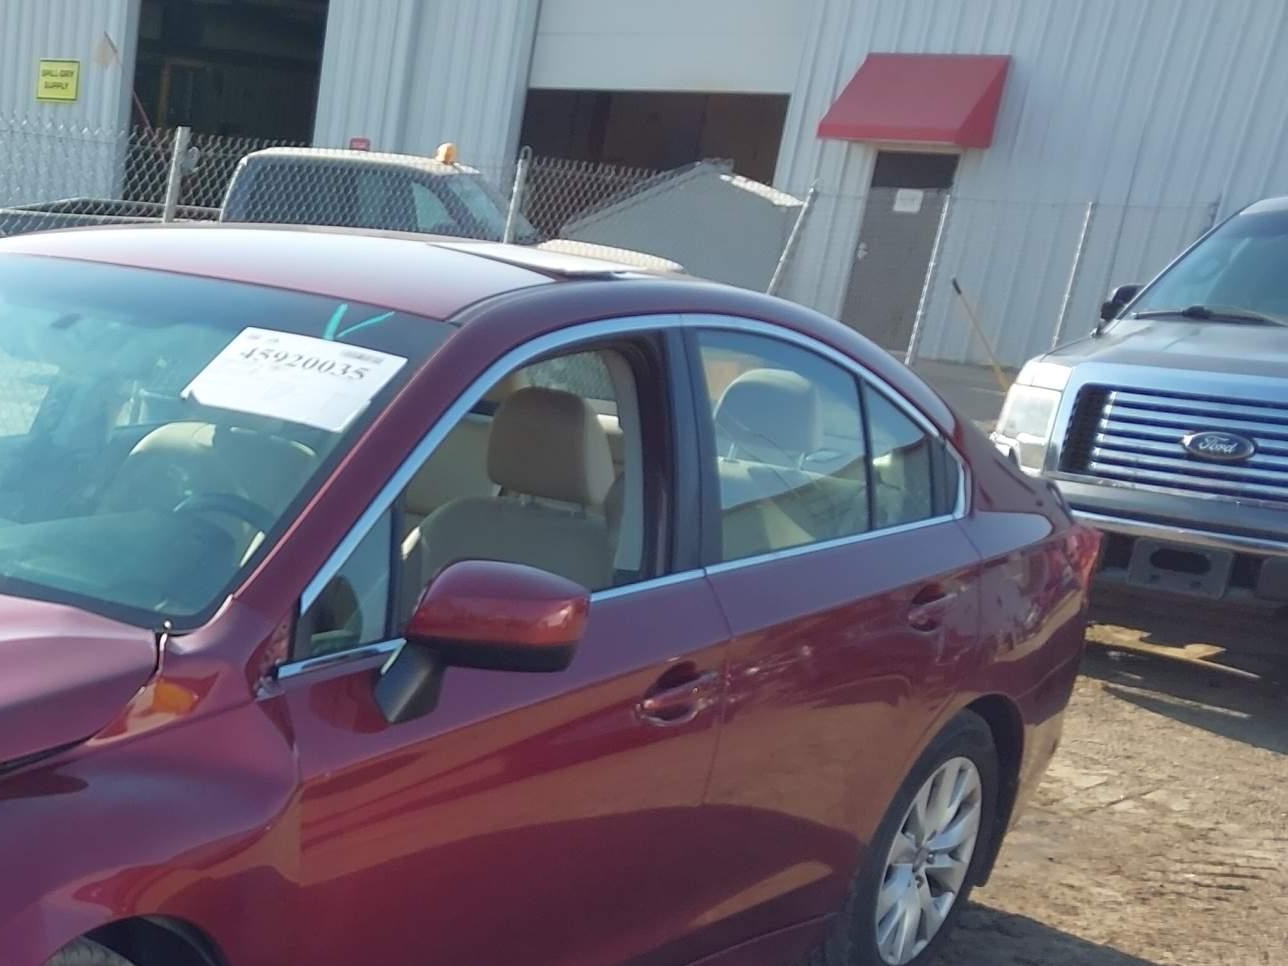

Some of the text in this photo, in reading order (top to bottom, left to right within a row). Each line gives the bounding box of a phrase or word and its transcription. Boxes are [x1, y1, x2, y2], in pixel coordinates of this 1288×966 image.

[44, 81, 69, 90] SUPPLY
[240, 346, 370, 381] 45920035
[1198, 435, 1238, 454] Ford
